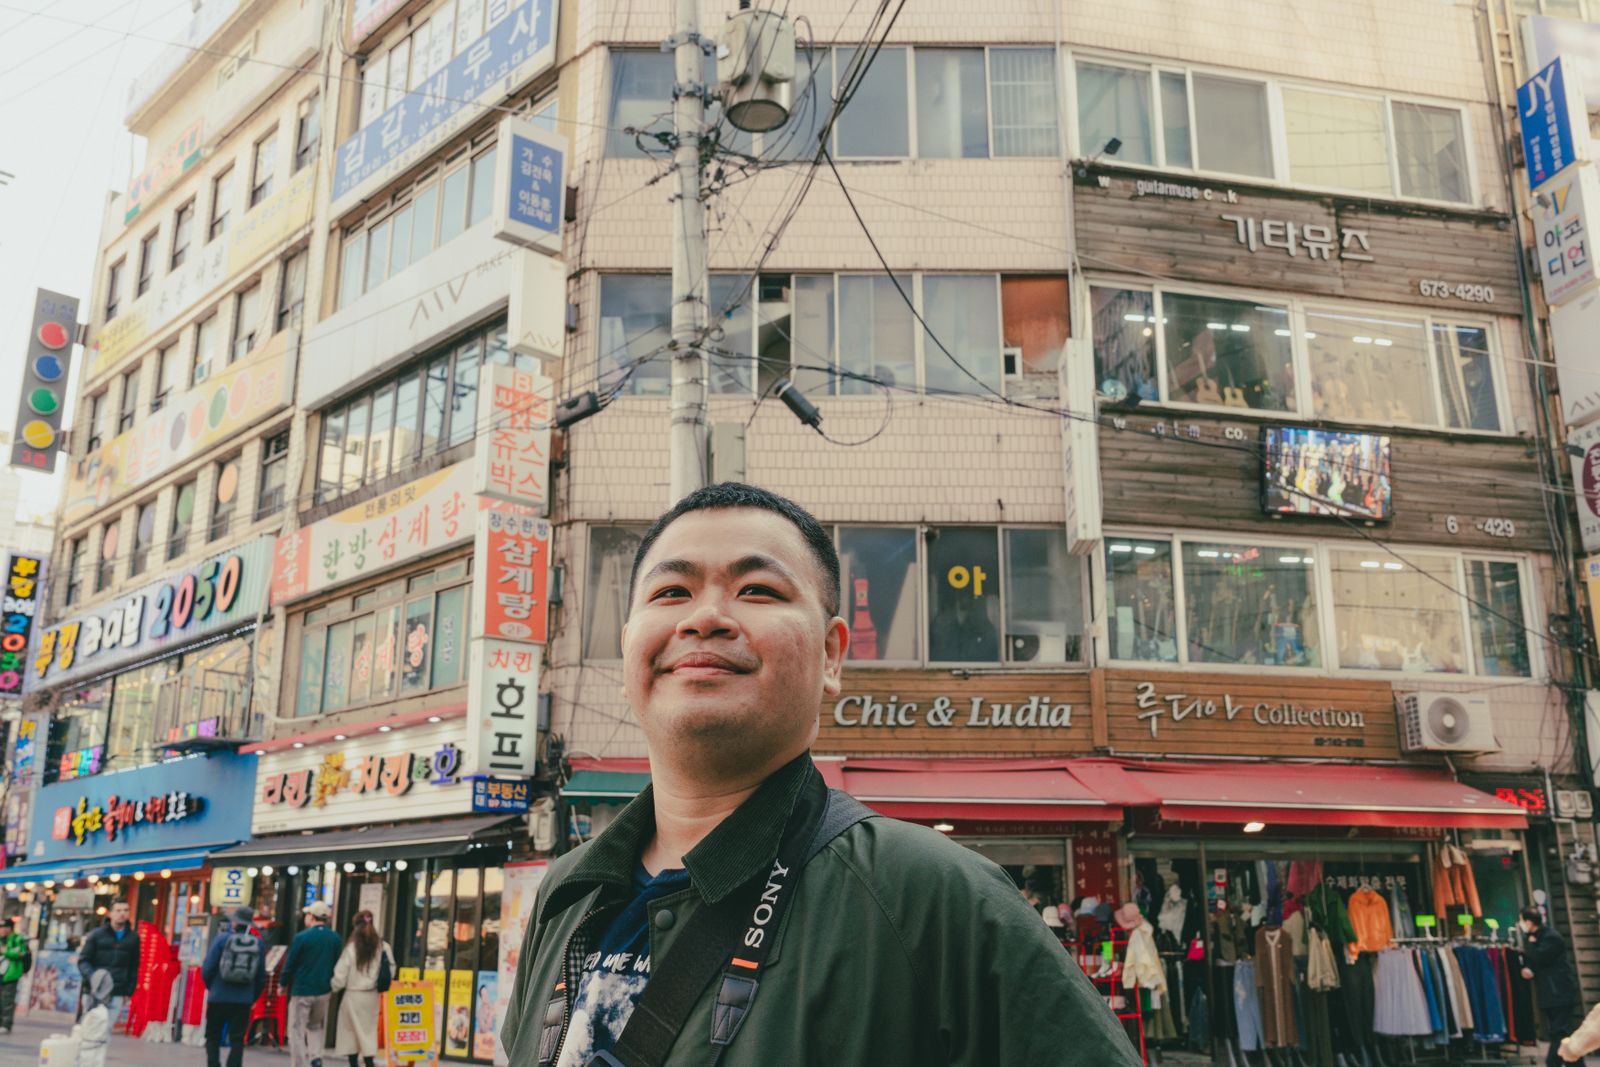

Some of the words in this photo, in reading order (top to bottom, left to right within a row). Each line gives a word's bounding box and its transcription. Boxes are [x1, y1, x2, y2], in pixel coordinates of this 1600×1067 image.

[1525, 64, 1555, 118] JY
[1136, 180, 1199, 200] guitarmuse
[1220, 214, 1375, 262] 기타뮤즈
[1419, 279, 1494, 304] 673-4290
[491, 462, 543, 499] 박스
[1446, 515, 1459, 535] 6
[496, 538, 539, 620] 삼계탕
[947, 565, 987, 597] 아
[150, 555, 243, 640] 2050
[487, 648, 533, 673] 치킨
[489, 677, 525, 770] 호프
[833, 695, 917, 727] Chic
[926, 696, 955, 727] &
[966, 695, 1073, 728] Ludia
[1253, 702, 1365, 728] Collection
[487, 783, 528, 801] 부동산
[744, 857, 789, 949] SONY
[399, 1011, 421, 1024] 치킨
